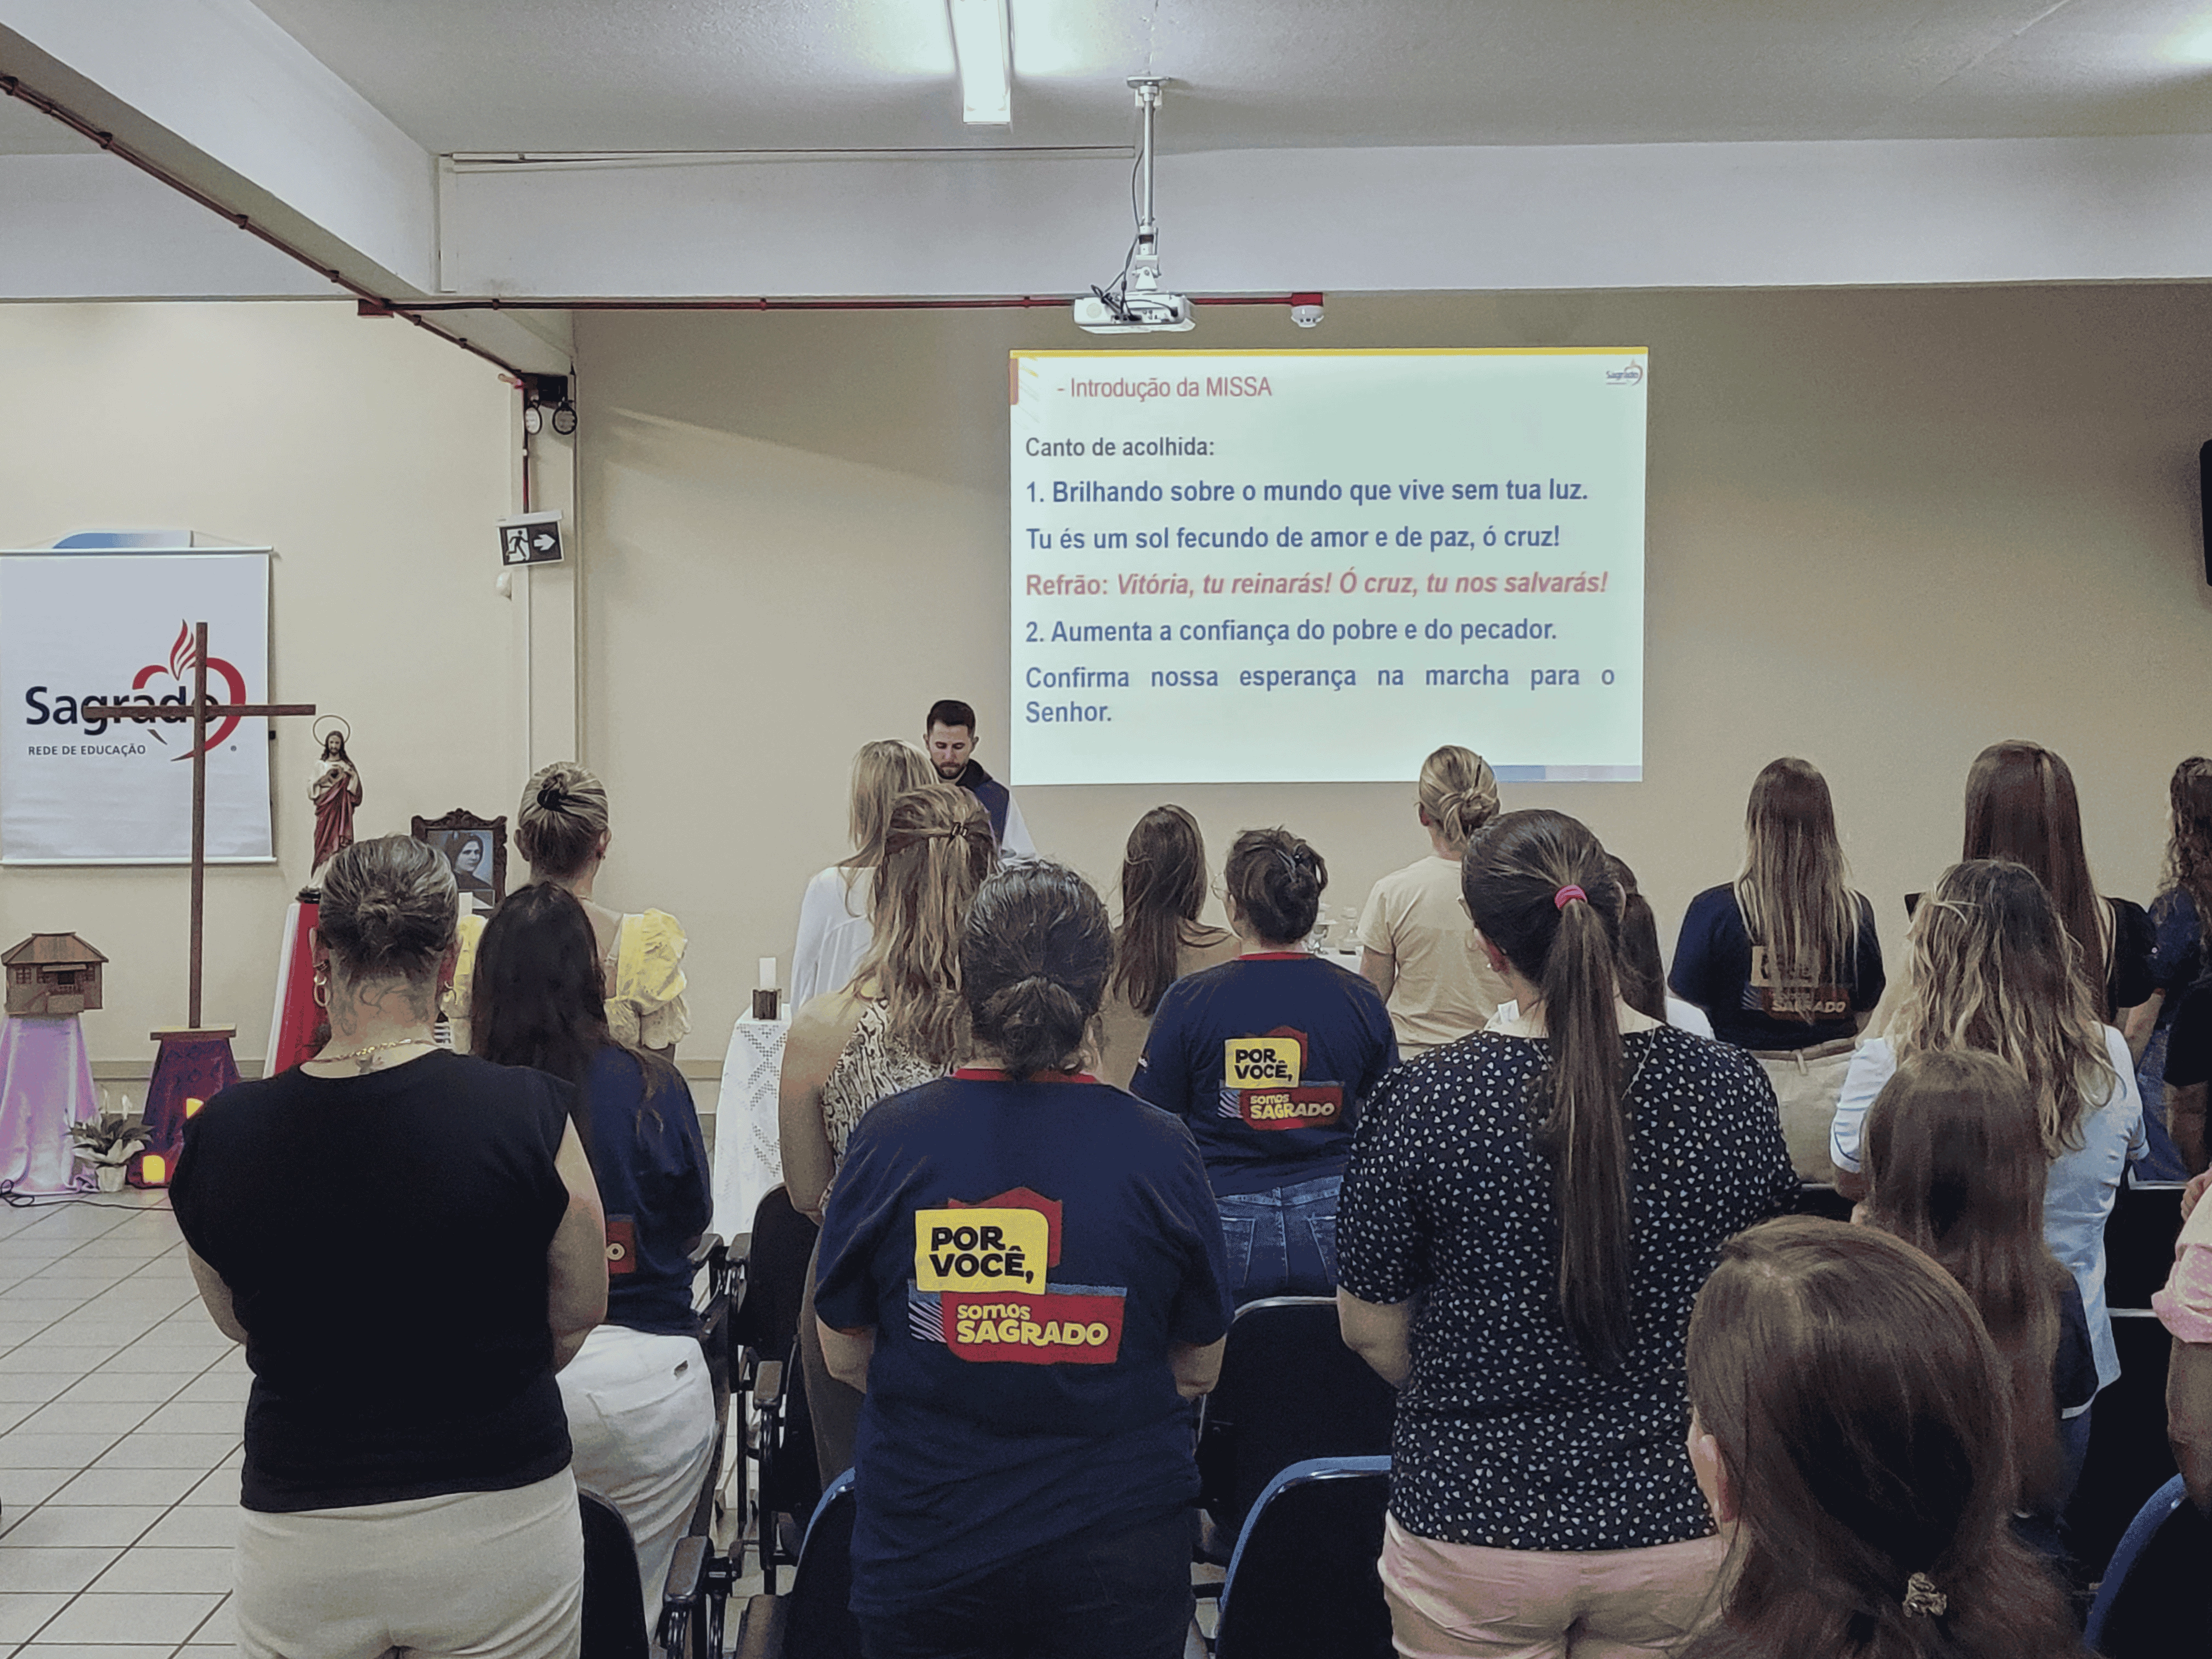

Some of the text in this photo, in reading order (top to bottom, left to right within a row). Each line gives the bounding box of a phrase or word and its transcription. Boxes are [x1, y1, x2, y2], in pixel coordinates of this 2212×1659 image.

[1071, 377, 1171, 403] Introdução
[1176, 377, 1199, 397] da
[1206, 376, 1273, 397] MISSA
[1025, 436, 1215, 457] Canto de acolhida:
[1026, 477, 1588, 507] 1. Brilhando sobre o mundo que vive sem tua luz.
[1025, 524, 1560, 553] Tu és um sol fecundo de amor e de paz, ó cruz!
[1026, 566, 1608, 598] Refrão: Vitória, tu reinarás! Ó cruz, tu nos salvarás!
[1025, 617, 1556, 646] 2. Aumenta a confiança do pobre e do pecador.
[1025, 663, 1615, 692] Confirma nossa esperança na marcha para o
[1025, 700, 1112, 724] Senhor.
[29, 743, 146, 757] REDE DE EDUCAÇÃO
[1771, 1001, 1846, 1013] SAADO
[1235, 1048, 1277, 1063] POR
[1234, 1059, 1293, 1082] VOCÊ,
[1250, 1103, 1335, 1120] SAGRADO
[931, 1226, 1006, 1252] POR
[929, 1245, 1034, 1284] VOCÊ,
[957, 1304, 1031, 1321] somos
[956, 1319, 1109, 1347] SAGRADO
